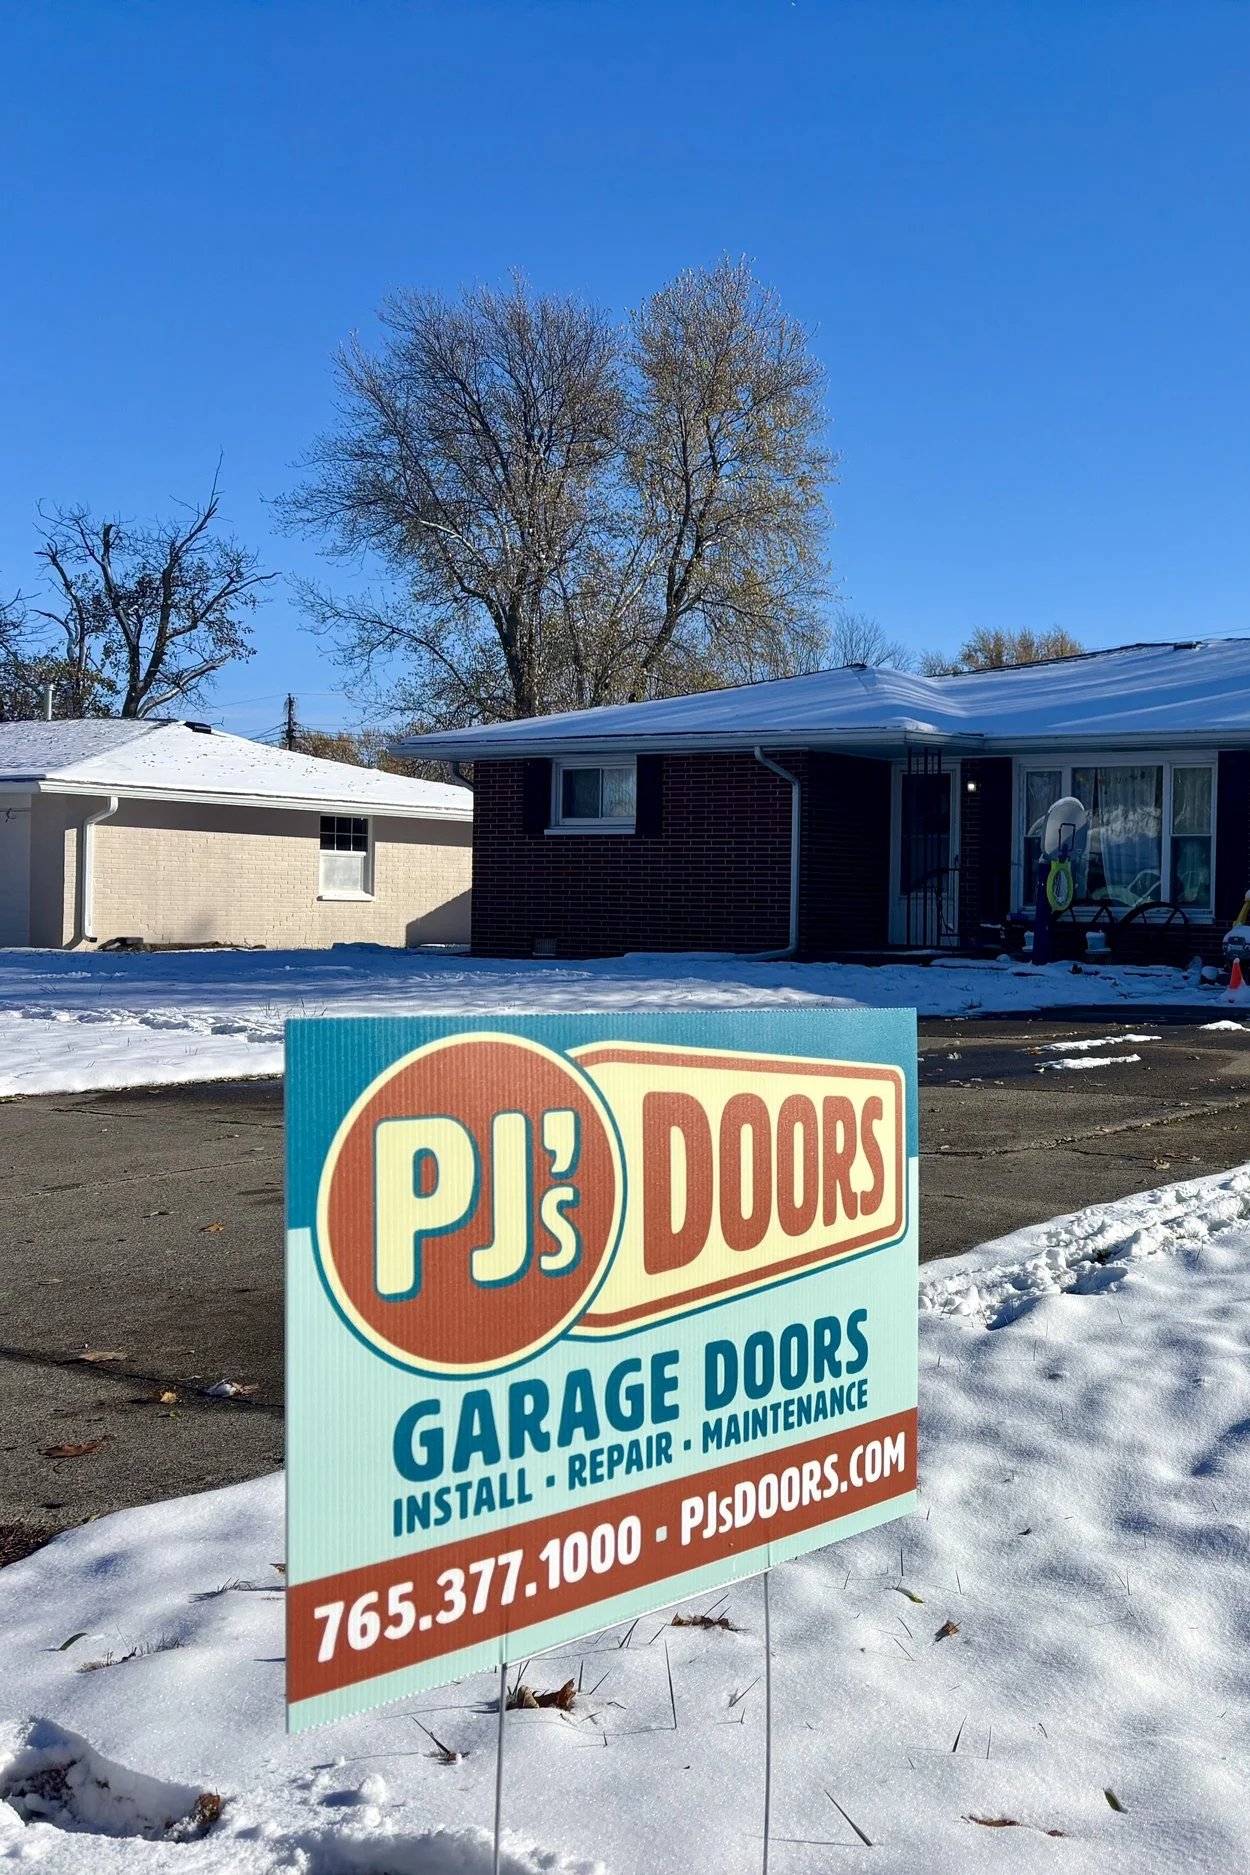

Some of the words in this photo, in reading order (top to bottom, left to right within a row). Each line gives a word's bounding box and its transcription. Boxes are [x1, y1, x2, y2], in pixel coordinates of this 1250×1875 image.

[643, 1093, 885, 1275] DOORS
[393, 1349, 680, 1482] GARAGE
[704, 1308, 869, 1411] DOORS
[393, 1467, 533, 1538] INSTALL
[568, 1431, 673, 1491] REPAIR
[702, 1378, 868, 1454] MAINTENANCE
[313, 1514, 642, 1664] 765.377.1000
[680, 1431, 906, 1547] PJsDOORS.COM
